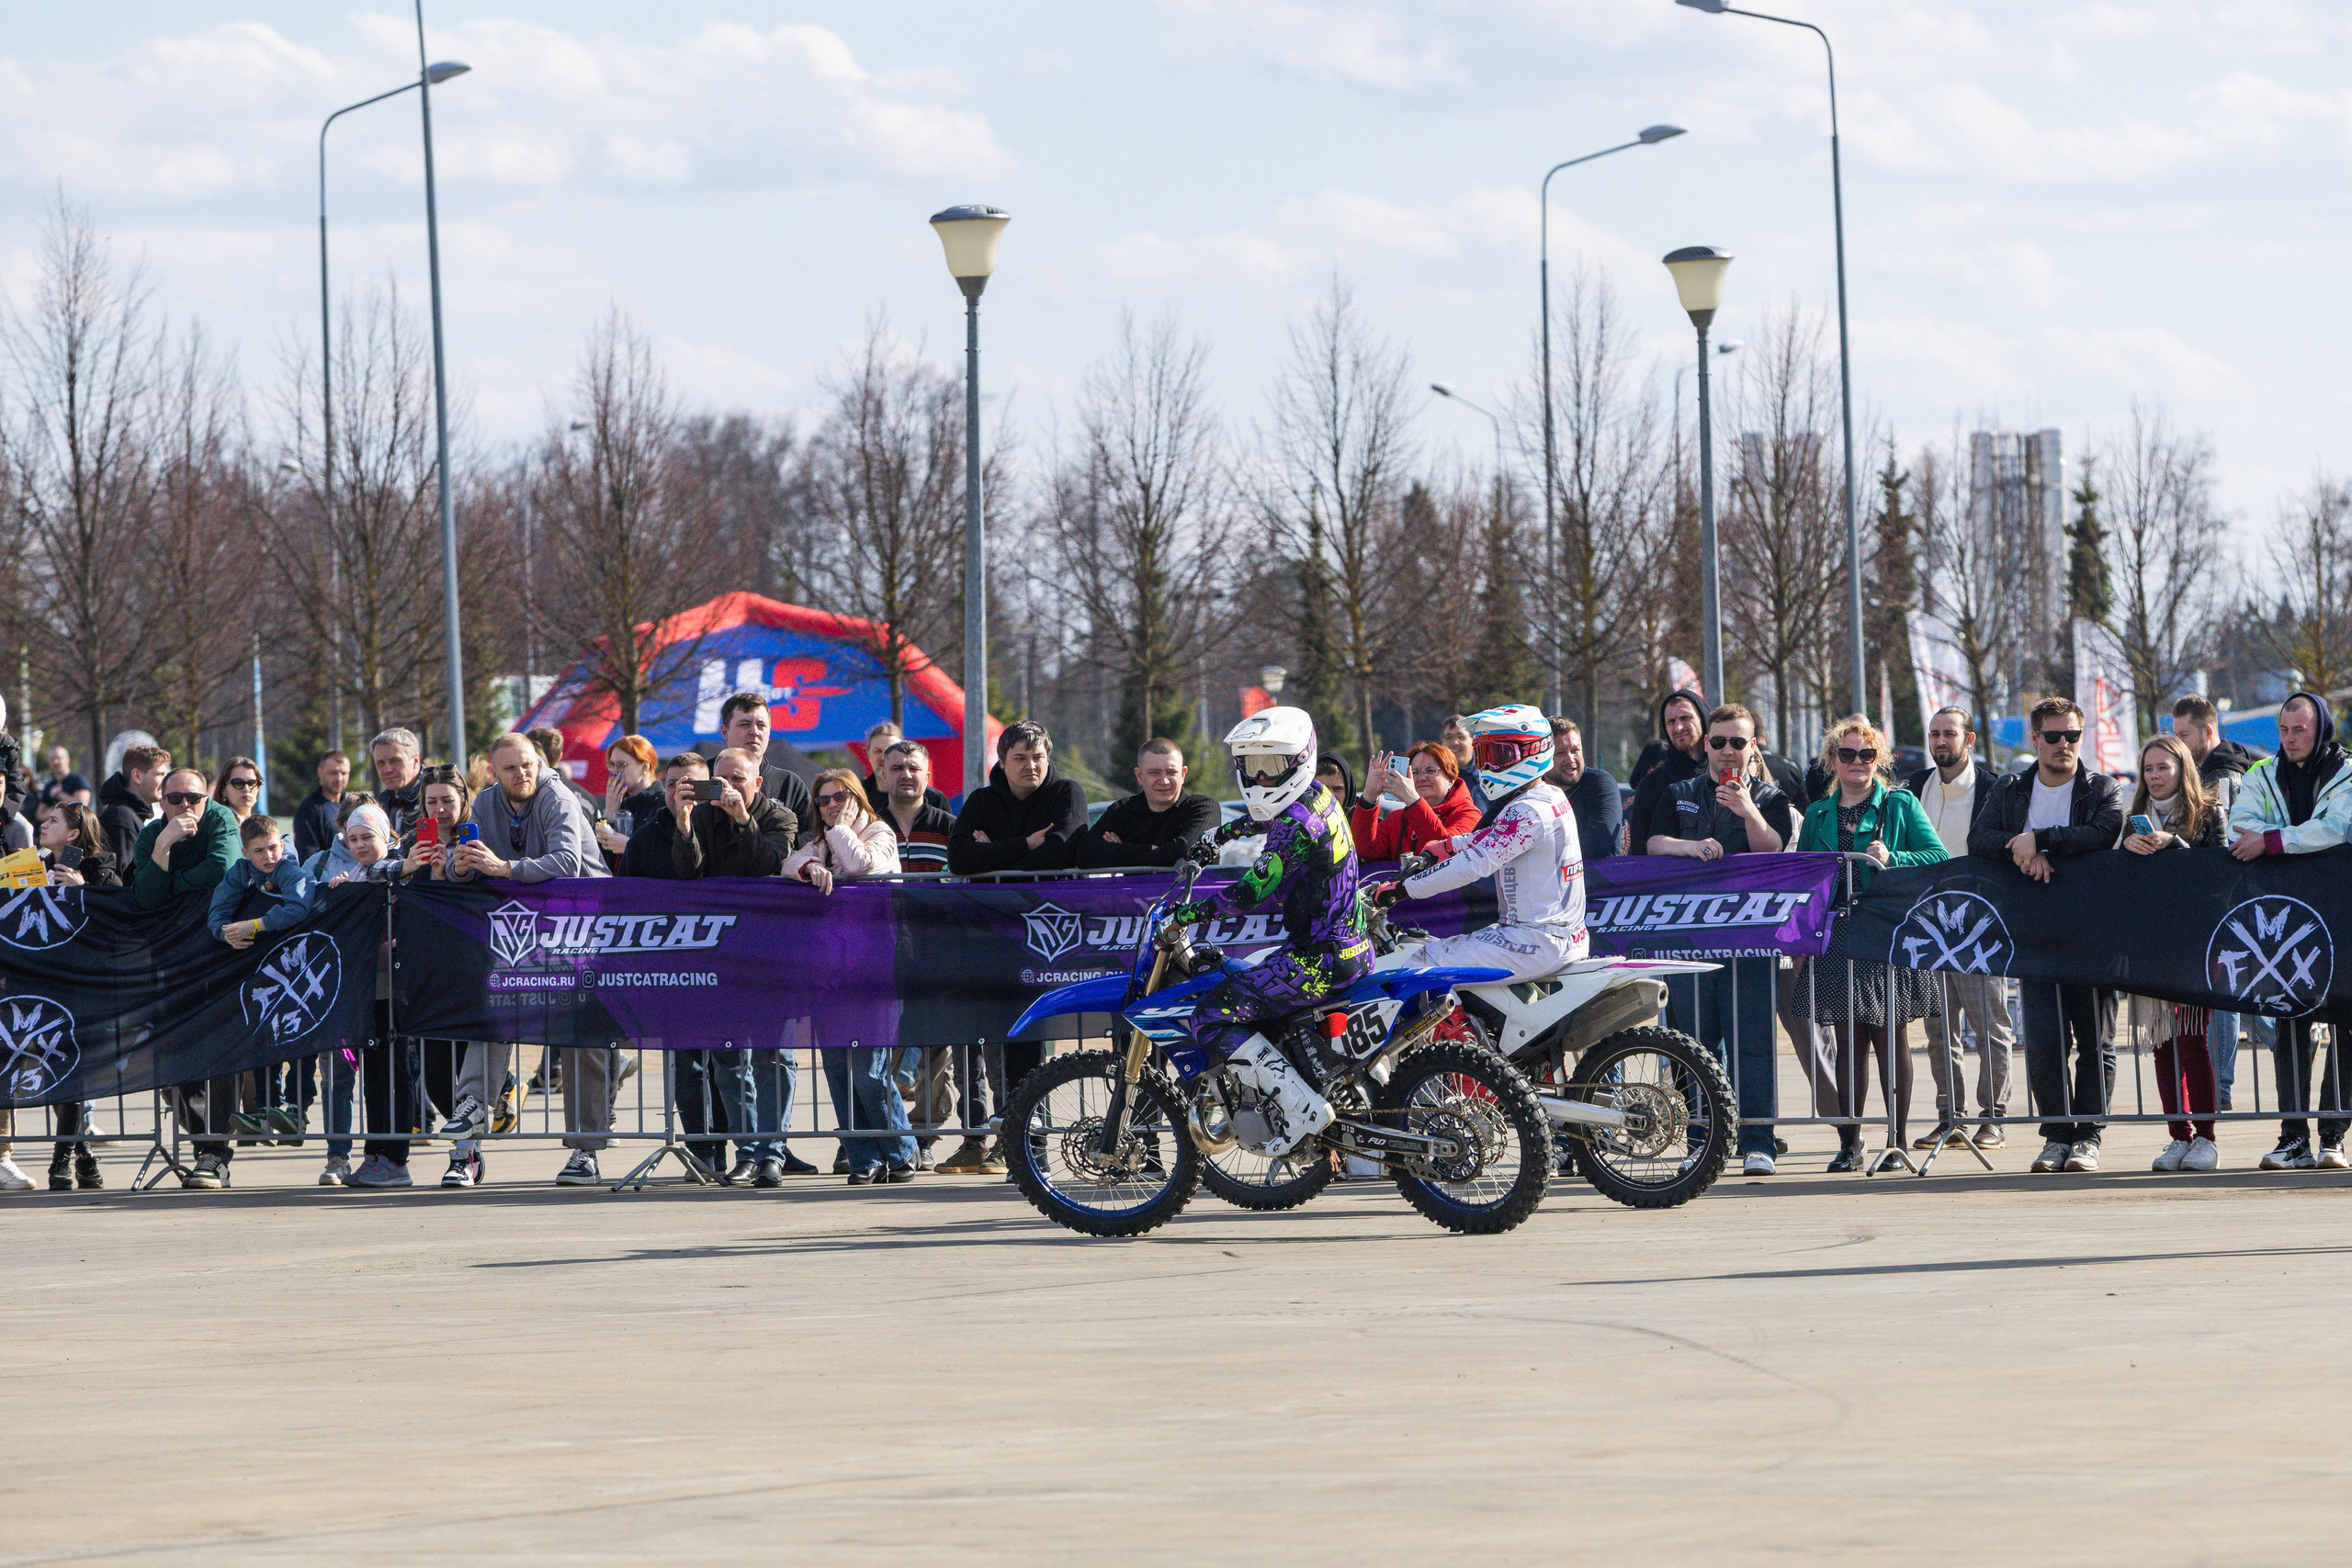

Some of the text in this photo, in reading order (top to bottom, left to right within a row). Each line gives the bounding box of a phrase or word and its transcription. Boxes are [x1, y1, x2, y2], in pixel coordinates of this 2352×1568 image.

[1585, 892, 1812, 928] JUSTCAT
[539, 915, 737, 948] JUSTCAT
[1596, 924, 1654, 934] RACING
[551, 947, 600, 955] RACING
[502, 976, 576, 987] JCRACING.RU
[597, 972, 718, 987] JUSTCATRACING
